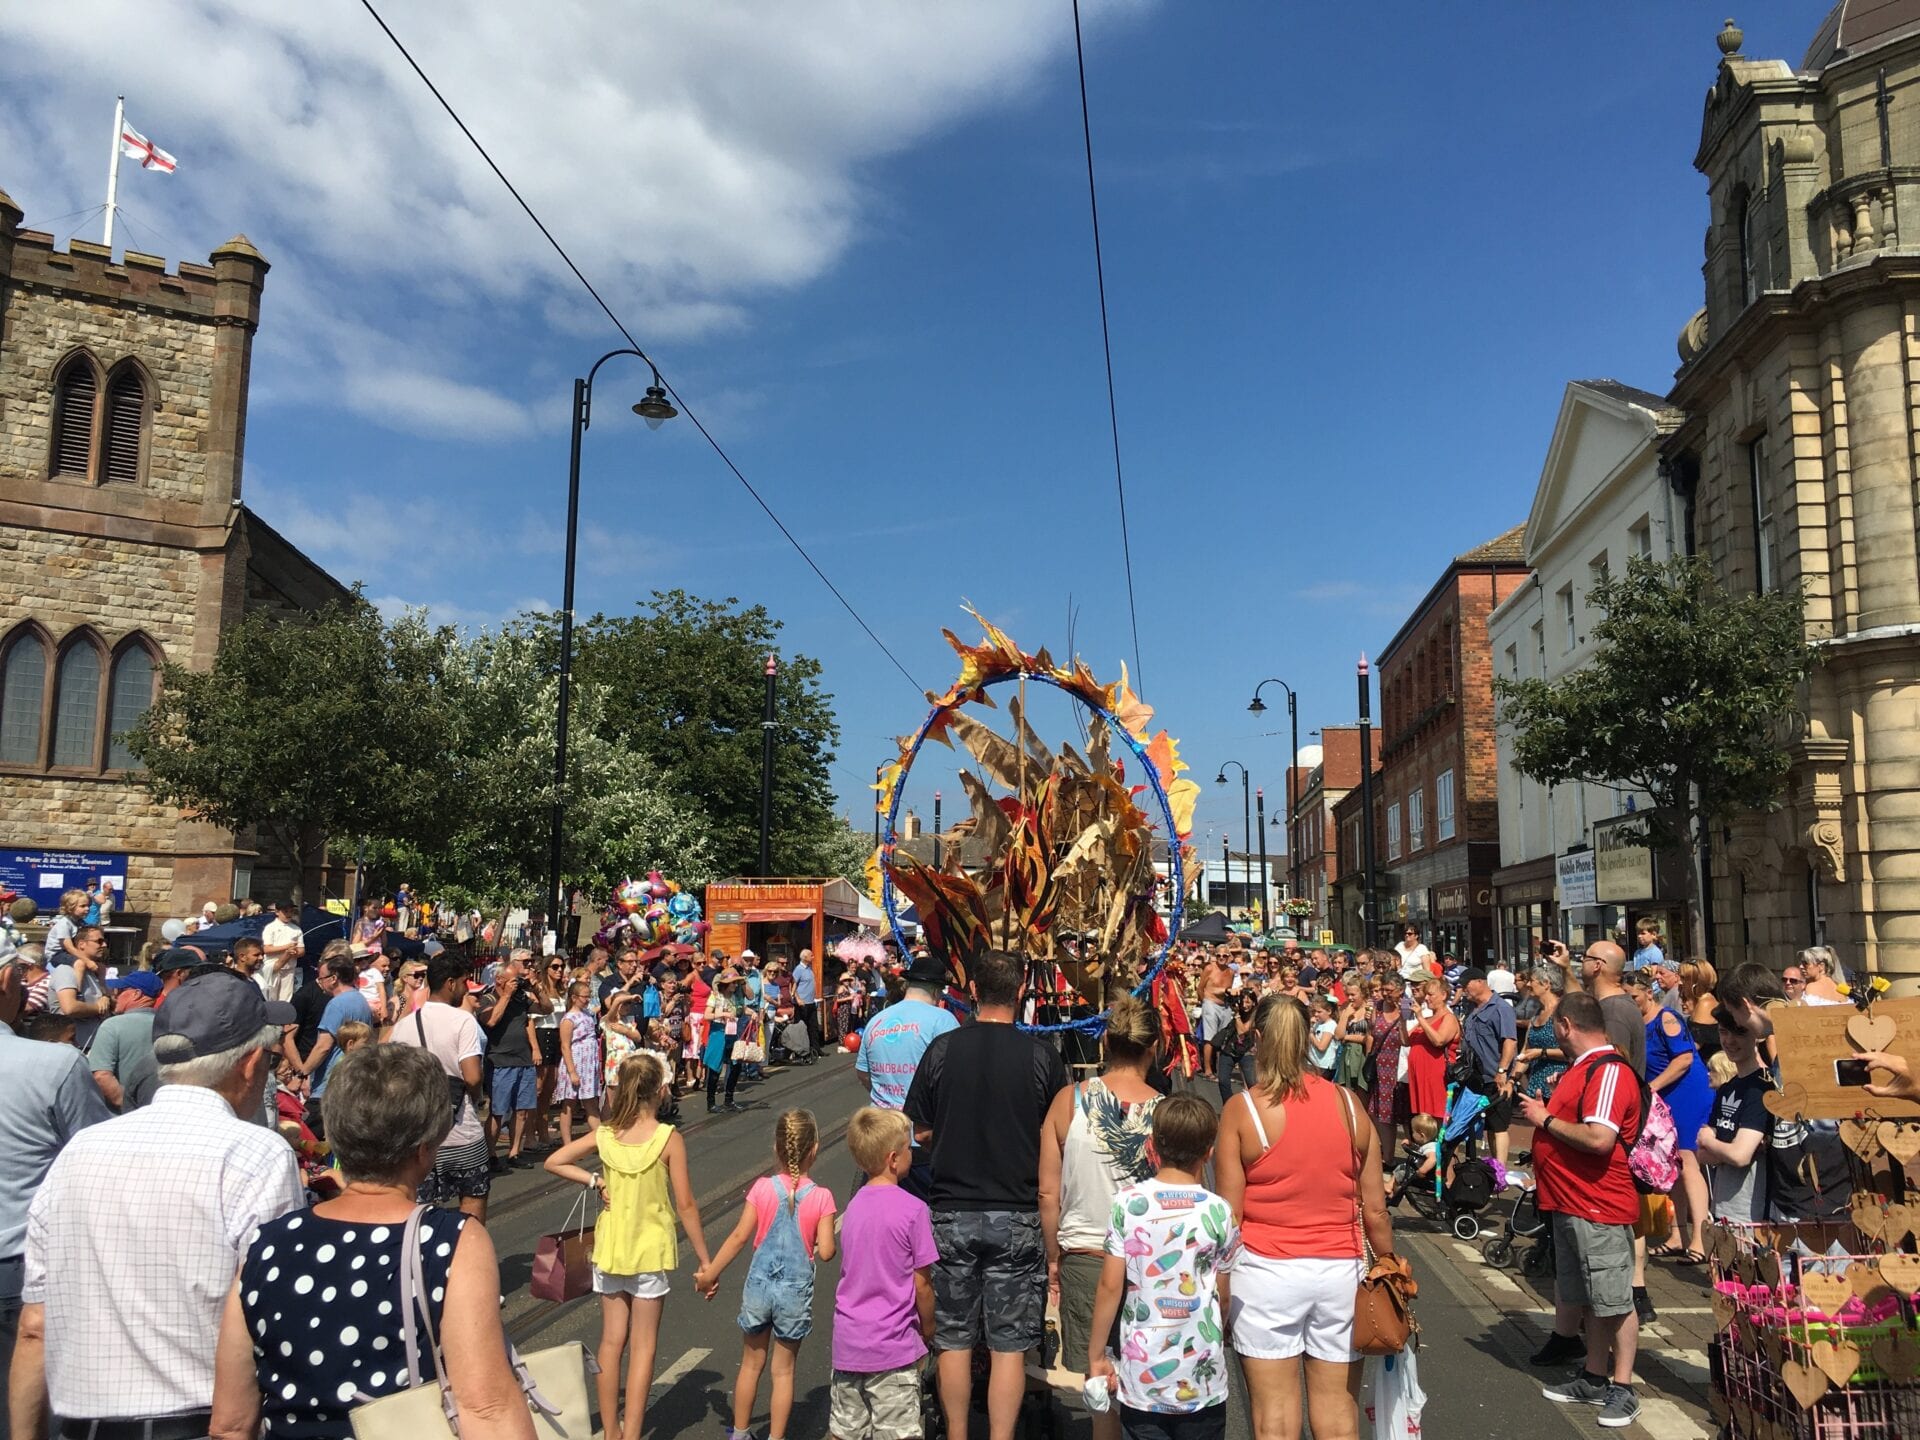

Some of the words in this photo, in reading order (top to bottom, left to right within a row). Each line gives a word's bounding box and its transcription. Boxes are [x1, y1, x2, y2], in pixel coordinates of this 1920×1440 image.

[81, 858, 112, 866] Fleetwood
[1560, 859, 1575, 876] Mobile
[1575, 857, 1591, 873] Phone
[1322, 932, 1331, 943] H
[871, 1061, 917, 1074] SANDBACH
[878, 1083, 905, 1097] CREWE
[1163, 1191, 1198, 1199] AWESOME
[1162, 1199, 1193, 1207] MOTEL
[1162, 1308, 1188, 1316] MOTEL
